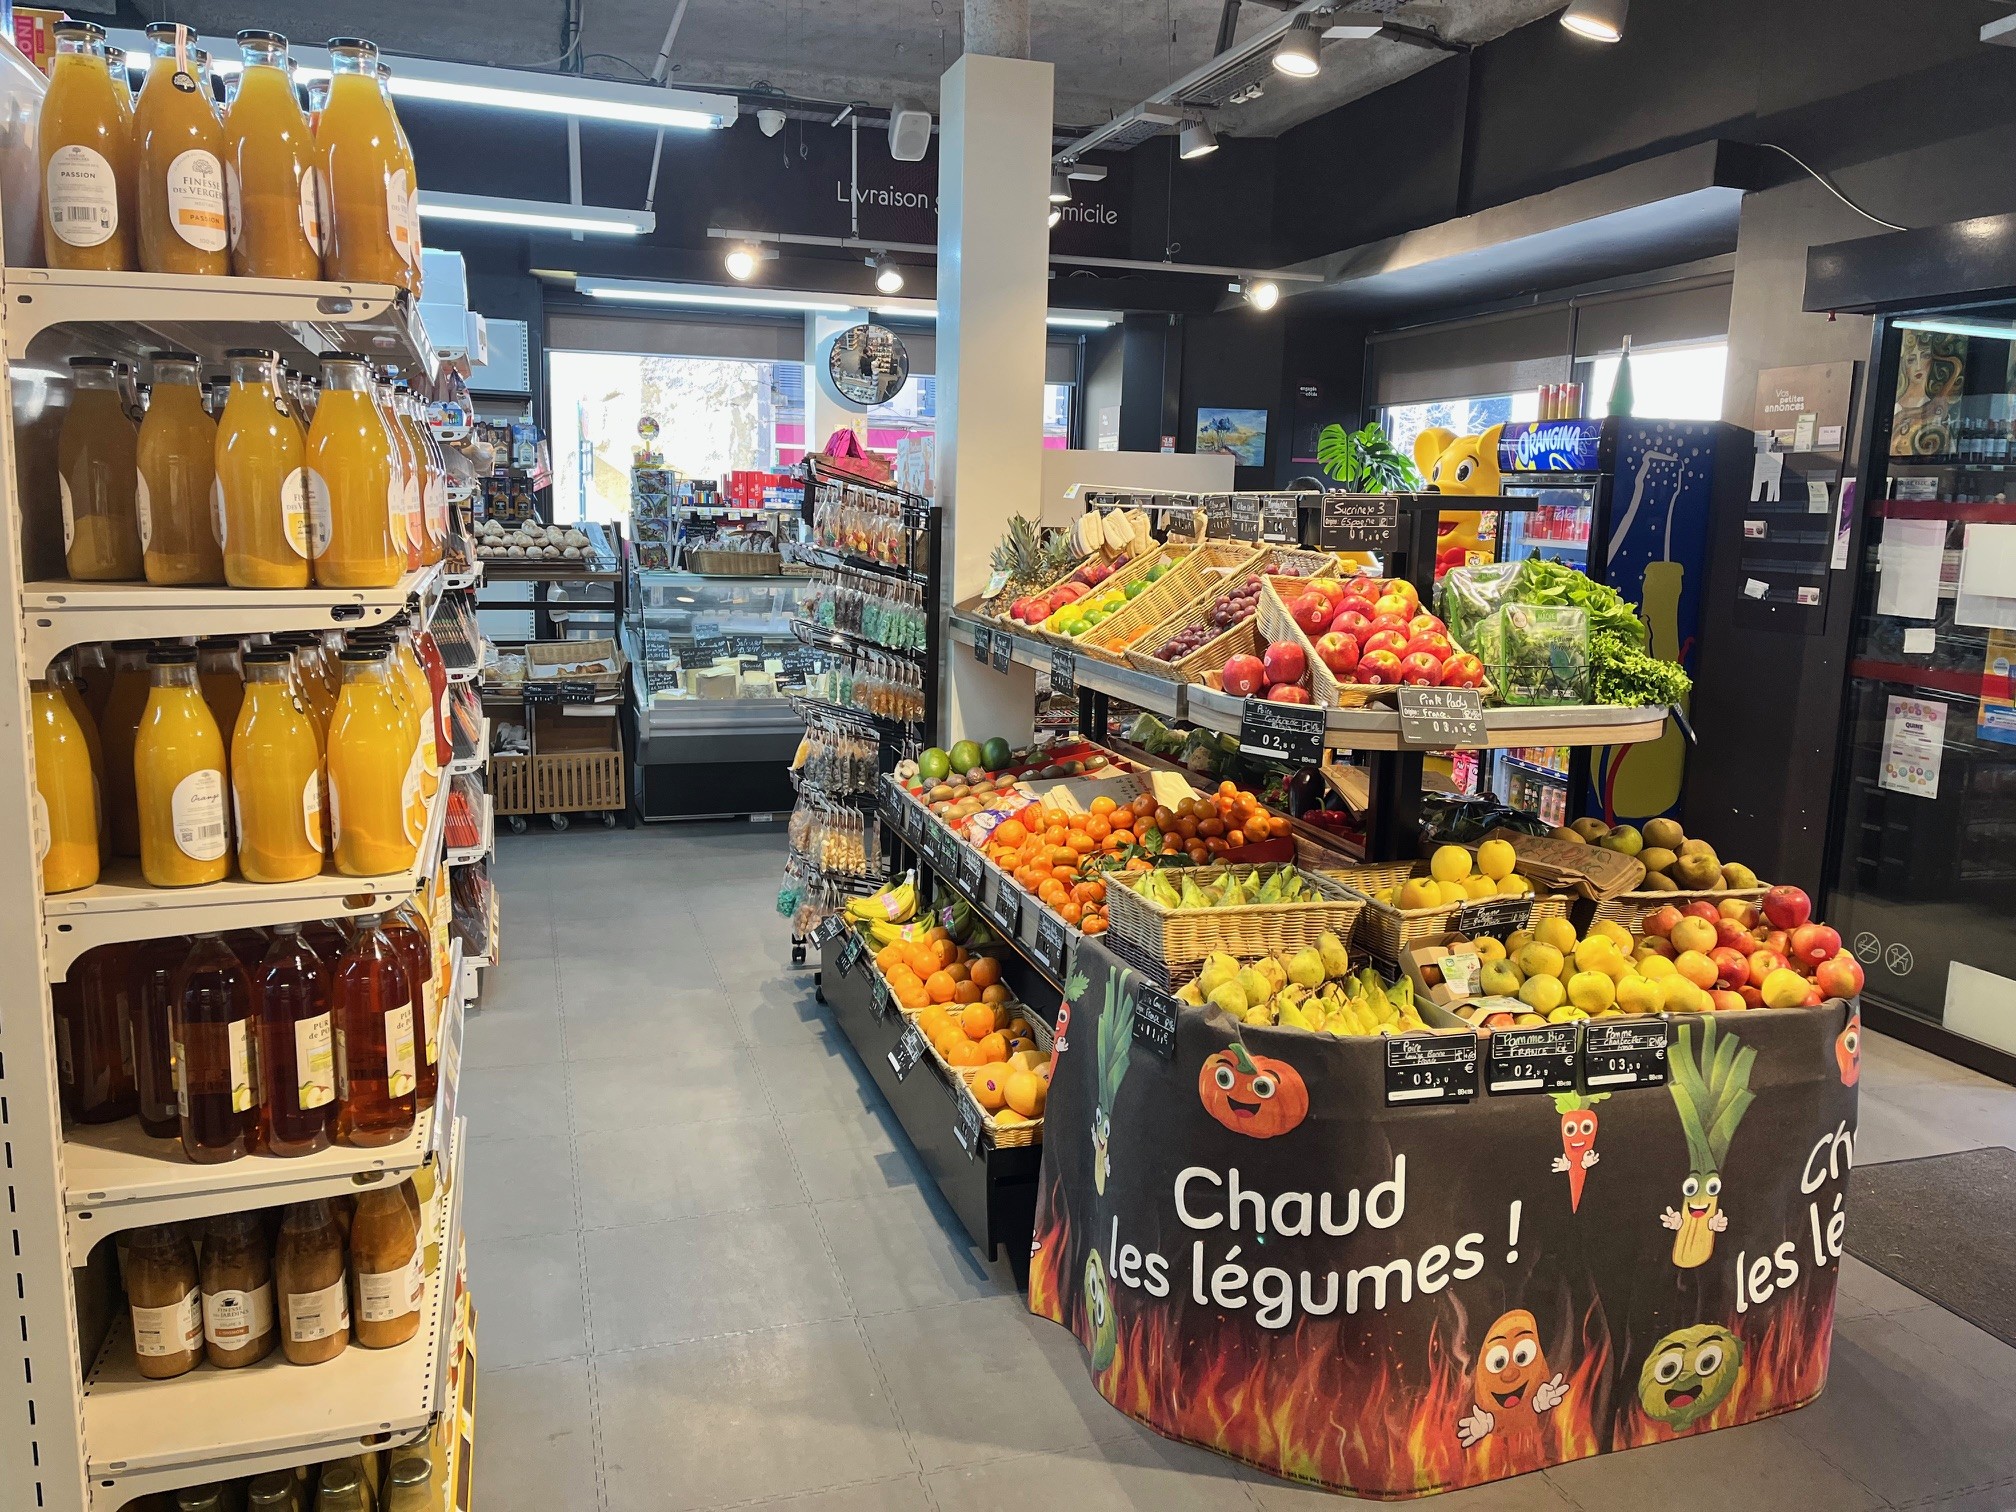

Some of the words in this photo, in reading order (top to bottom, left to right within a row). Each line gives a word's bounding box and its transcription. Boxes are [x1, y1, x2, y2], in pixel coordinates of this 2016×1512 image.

[183, 176, 221, 190] FINESSE
[837, 181, 928, 209] Lvraison
[189, 214, 220, 224] PASSION
[1775, 389, 1790, 397] Vos
[1780, 395, 1804, 404] petites
[1764, 403, 1805, 413] annonces
[1377, 502, 1385, 514] 3
[1419, 693, 1442, 705] Pink
[1257, 704, 1272, 715] Poire
[1905, 722, 1924, 730] QUINE
[1310, 735, 1321, 746] €
[190, 794, 220, 803] Orange
[313, 1020, 329, 1031] PUR
[308, 1032, 318, 1040] de
[1606, 1027, 1633, 1039] Pomme
[1503, 1033, 1545, 1047] Pomme
[1547, 1031, 1565, 1043] Bio
[1403, 1040, 1422, 1053] Poire
[1655, 1049, 1665, 1060] €
[1564, 1055, 1574, 1066] €
[1464, 1062, 1475, 1074] €
[1800, 1120, 1857, 1195] Ch
[1174, 1153, 1406, 1237] Chaud
[1109, 1214, 1170, 1297] les
[1192, 1232, 1485, 1329] légumes
[1506, 1200, 1523, 1264] !
[1736, 1241, 1799, 1314] les
